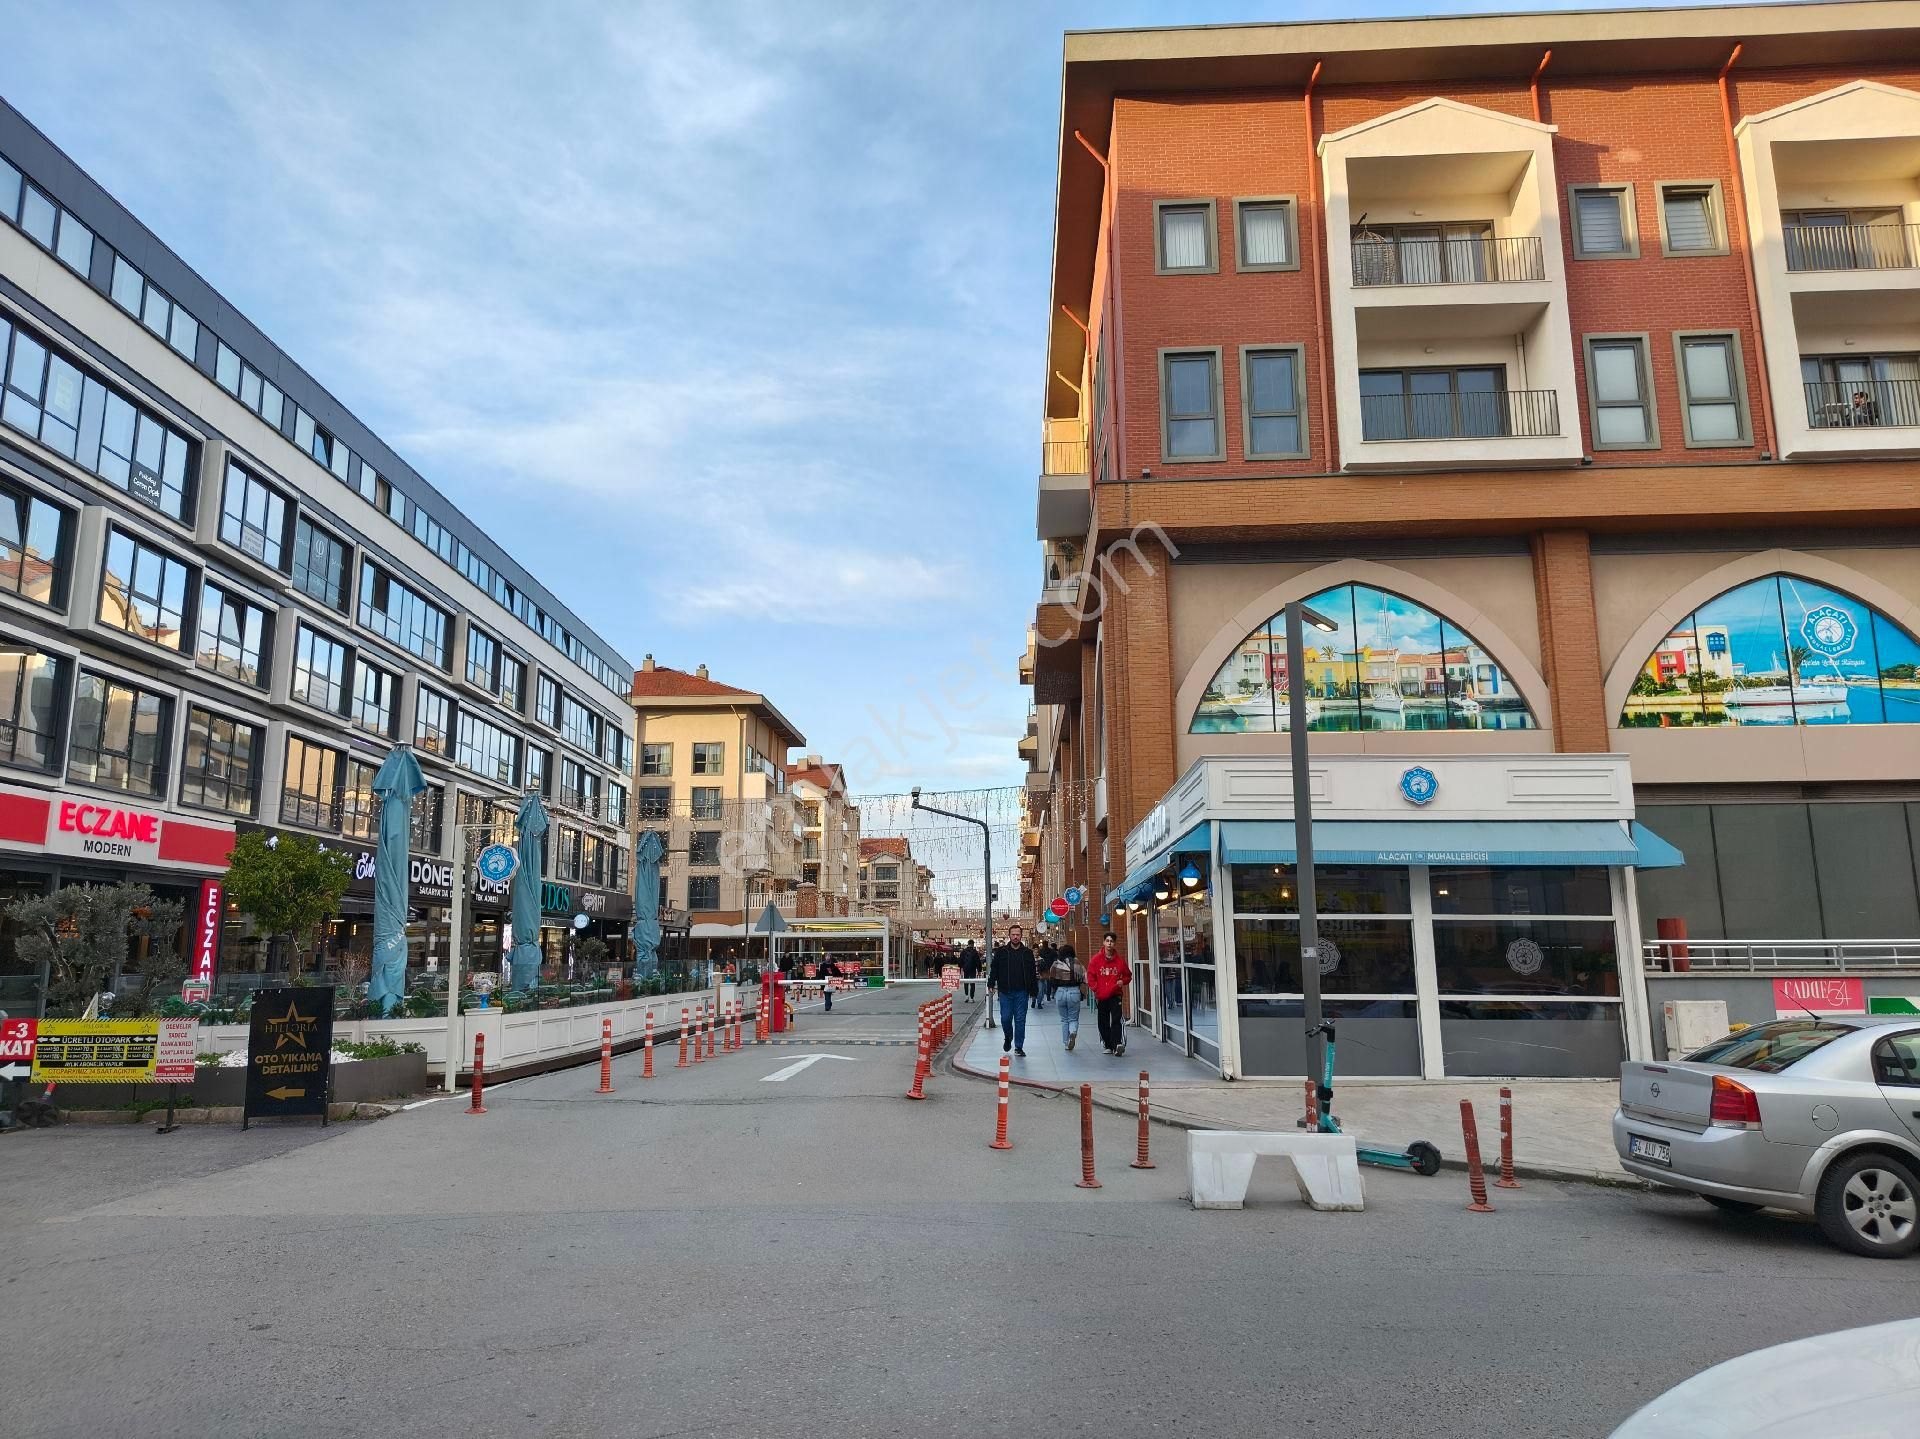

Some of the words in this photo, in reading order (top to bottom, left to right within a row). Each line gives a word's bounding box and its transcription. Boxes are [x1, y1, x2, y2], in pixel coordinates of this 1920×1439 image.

[1808, 608, 1848, 624] ALAÇATI
[58, 800, 159, 843] ECZANE
[83, 839, 132, 857] MODERN
[8, 1022, 29, 1039] -3
[0, 1040, 35, 1056] KAT
[62, 1036, 94, 1044] ÜCRETLİ
[95, 1036, 132, 1044] OTOPARK
[254, 1054, 279, 1064] OTO
[280, 1052, 323, 1062] YIKAMA
[262, 1063, 319, 1075] DETAILING
